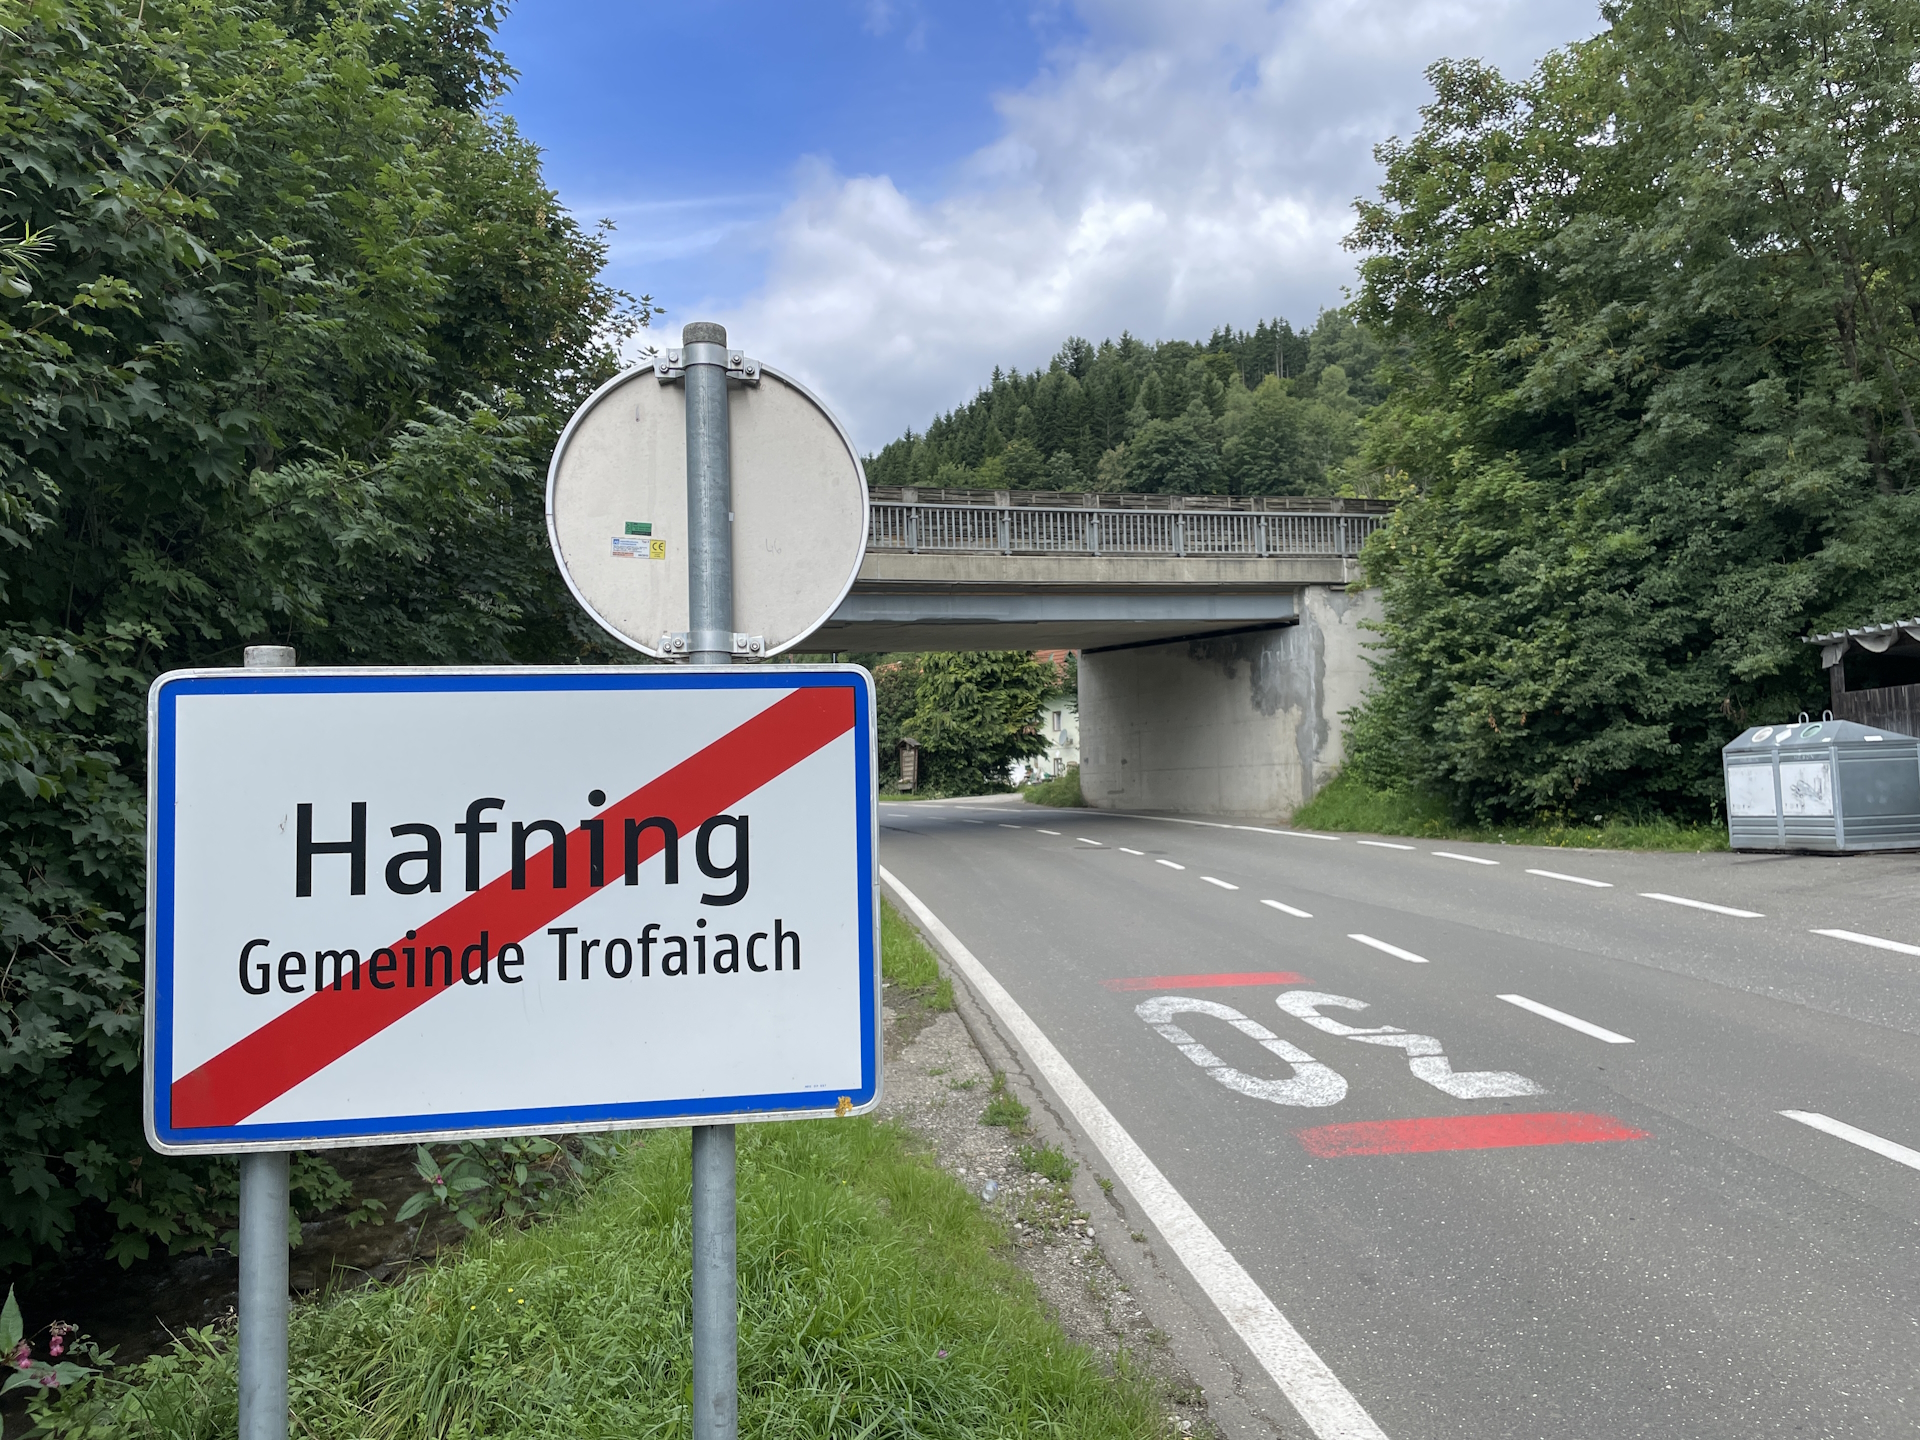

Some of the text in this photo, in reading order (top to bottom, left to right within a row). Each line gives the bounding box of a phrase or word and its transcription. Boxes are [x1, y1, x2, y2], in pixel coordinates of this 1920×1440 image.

[652, 542, 664, 551] CE
[296, 790, 751, 907] Hafning
[239, 918, 801, 995] Gemeinde Trofaiach
[1134, 990, 1548, 1108] 30
